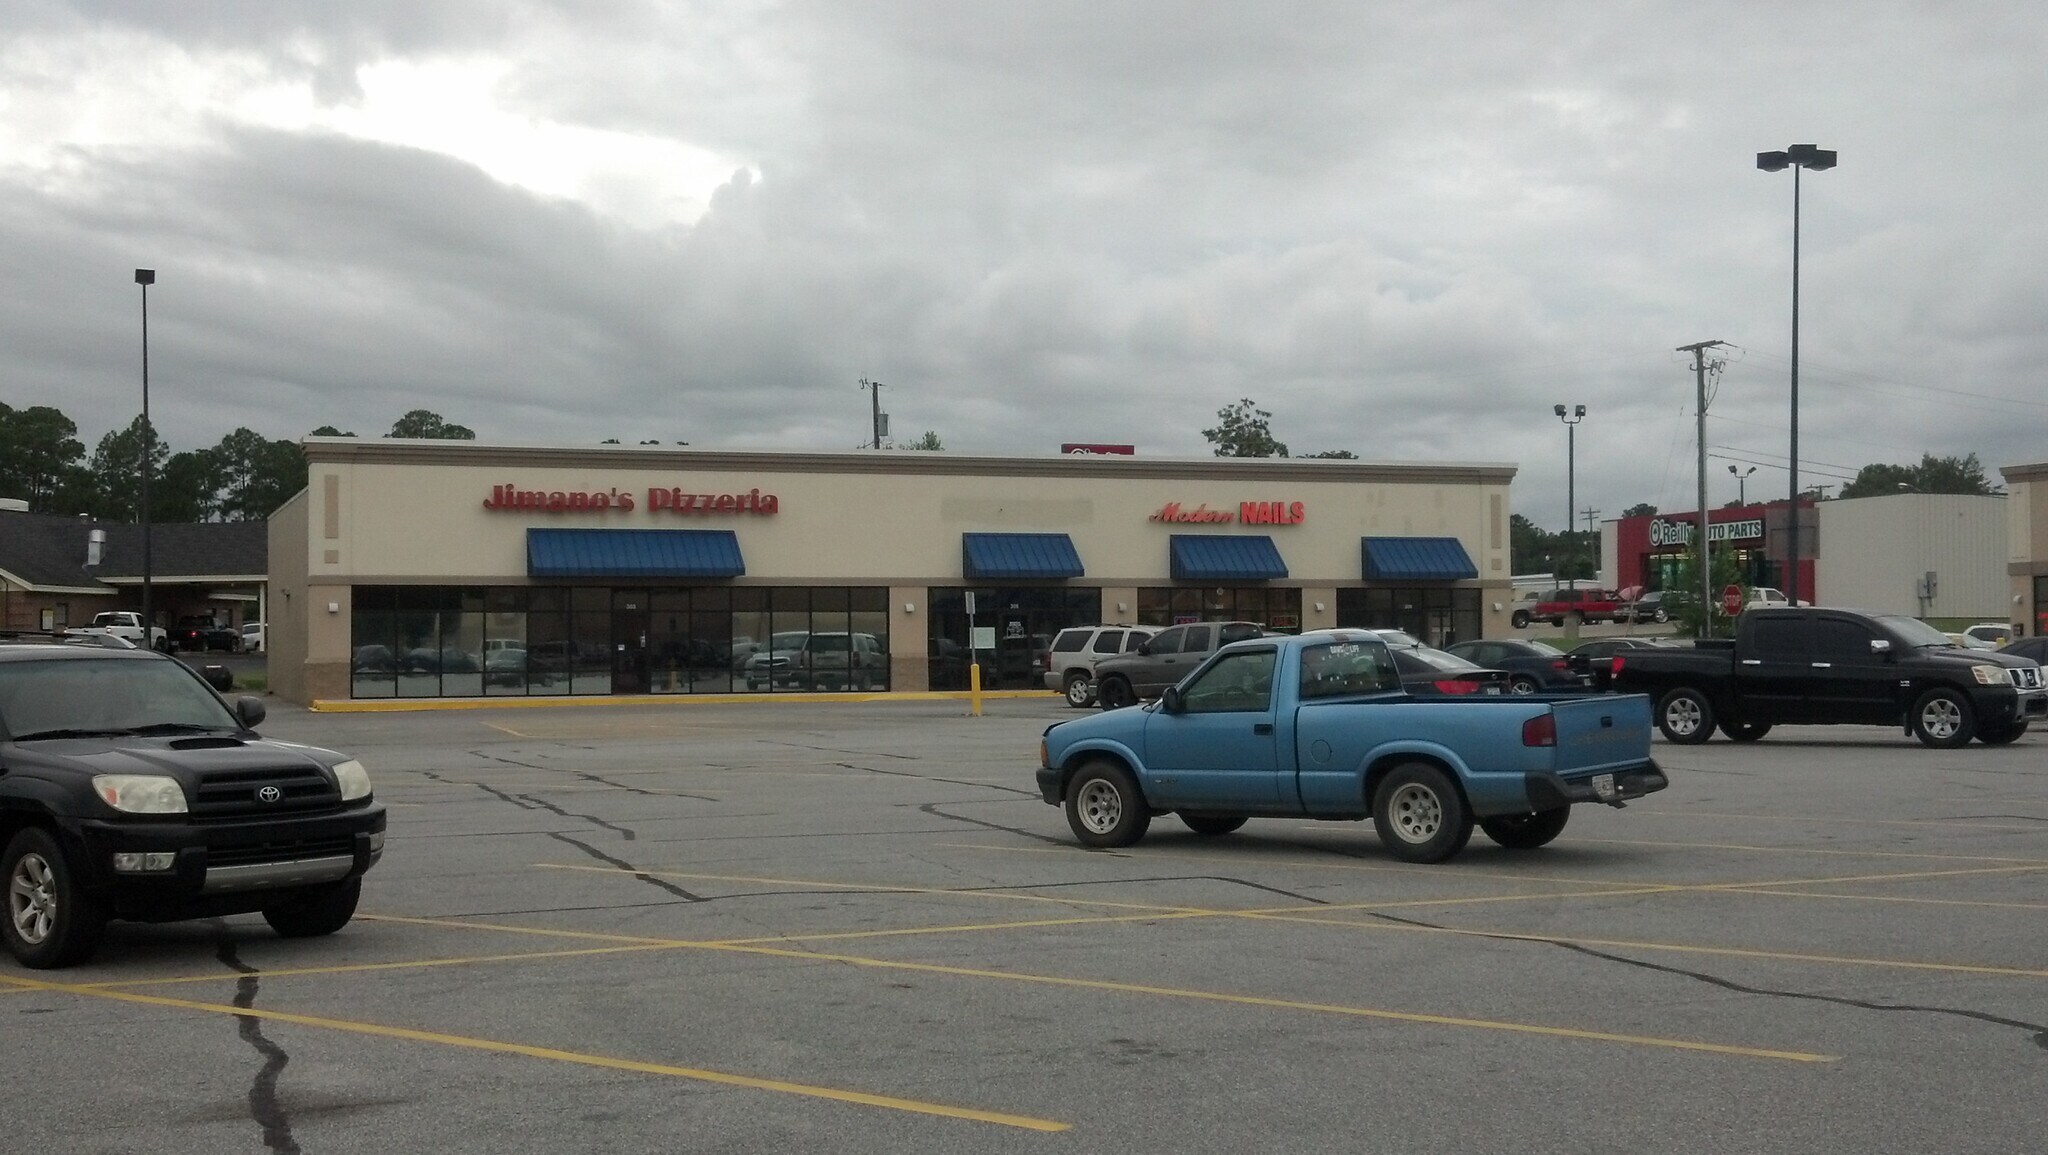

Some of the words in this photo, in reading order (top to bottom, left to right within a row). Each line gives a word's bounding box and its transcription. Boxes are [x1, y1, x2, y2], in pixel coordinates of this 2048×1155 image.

[483, 483, 635, 513] Jimano's
[648, 487, 779, 515] Pizzeria
[1148, 502, 1235, 523] Modern
[1240, 501, 1305, 524] NAILS
[1649, 519, 1694, 546] O'Reilly
[1728, 521, 1761, 540] PARTS
[1724, 595, 1741, 607] STOP
